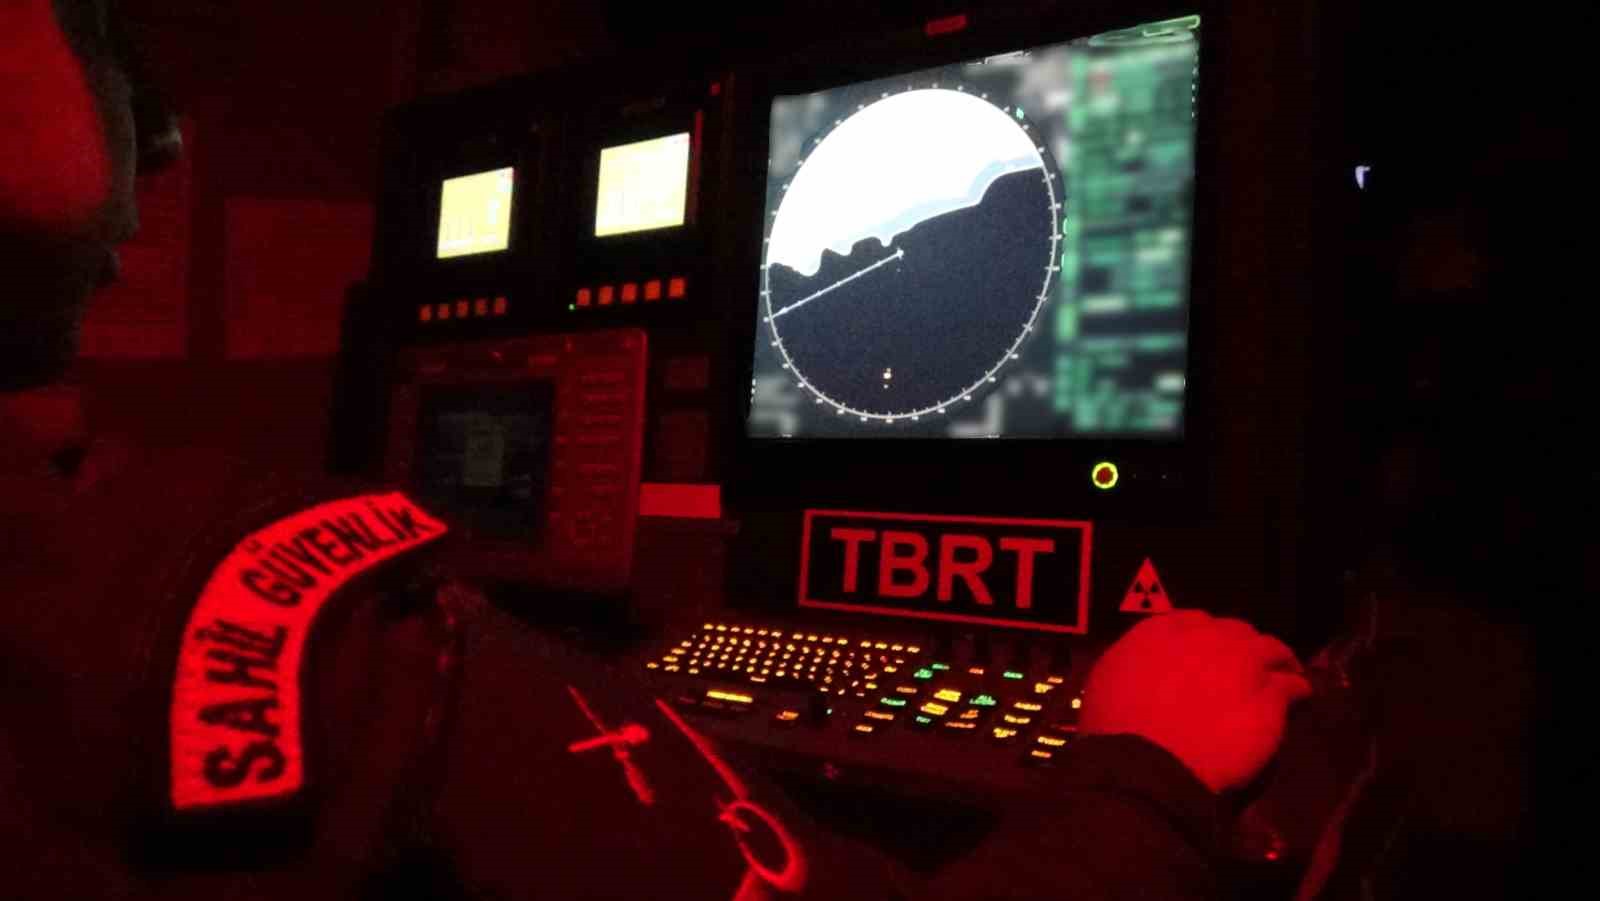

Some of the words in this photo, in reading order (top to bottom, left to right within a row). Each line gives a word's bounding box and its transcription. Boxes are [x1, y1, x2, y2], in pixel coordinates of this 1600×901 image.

[240, 501, 437, 608] GÜVENLİK
[830, 527, 1056, 609] TBRT
[195, 618, 288, 789] SAHİL
